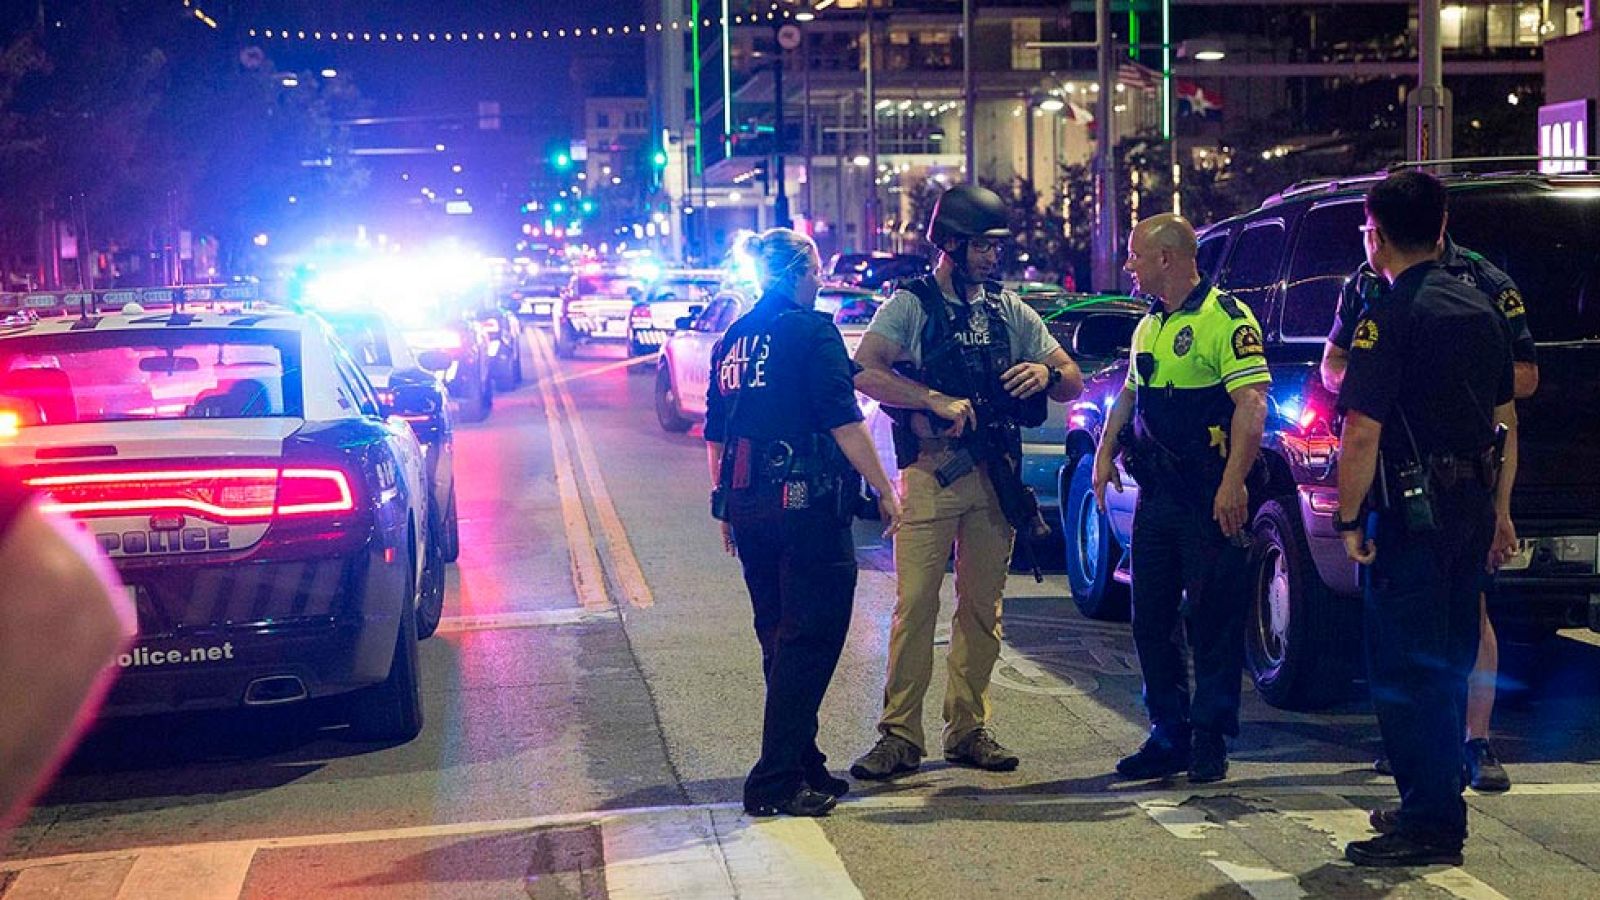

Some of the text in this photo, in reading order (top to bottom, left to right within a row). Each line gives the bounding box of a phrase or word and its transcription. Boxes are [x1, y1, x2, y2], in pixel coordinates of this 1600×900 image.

[953, 331, 991, 346] OLICE
[97, 526, 229, 555] POLICE
[117, 641, 234, 668] olice.net
